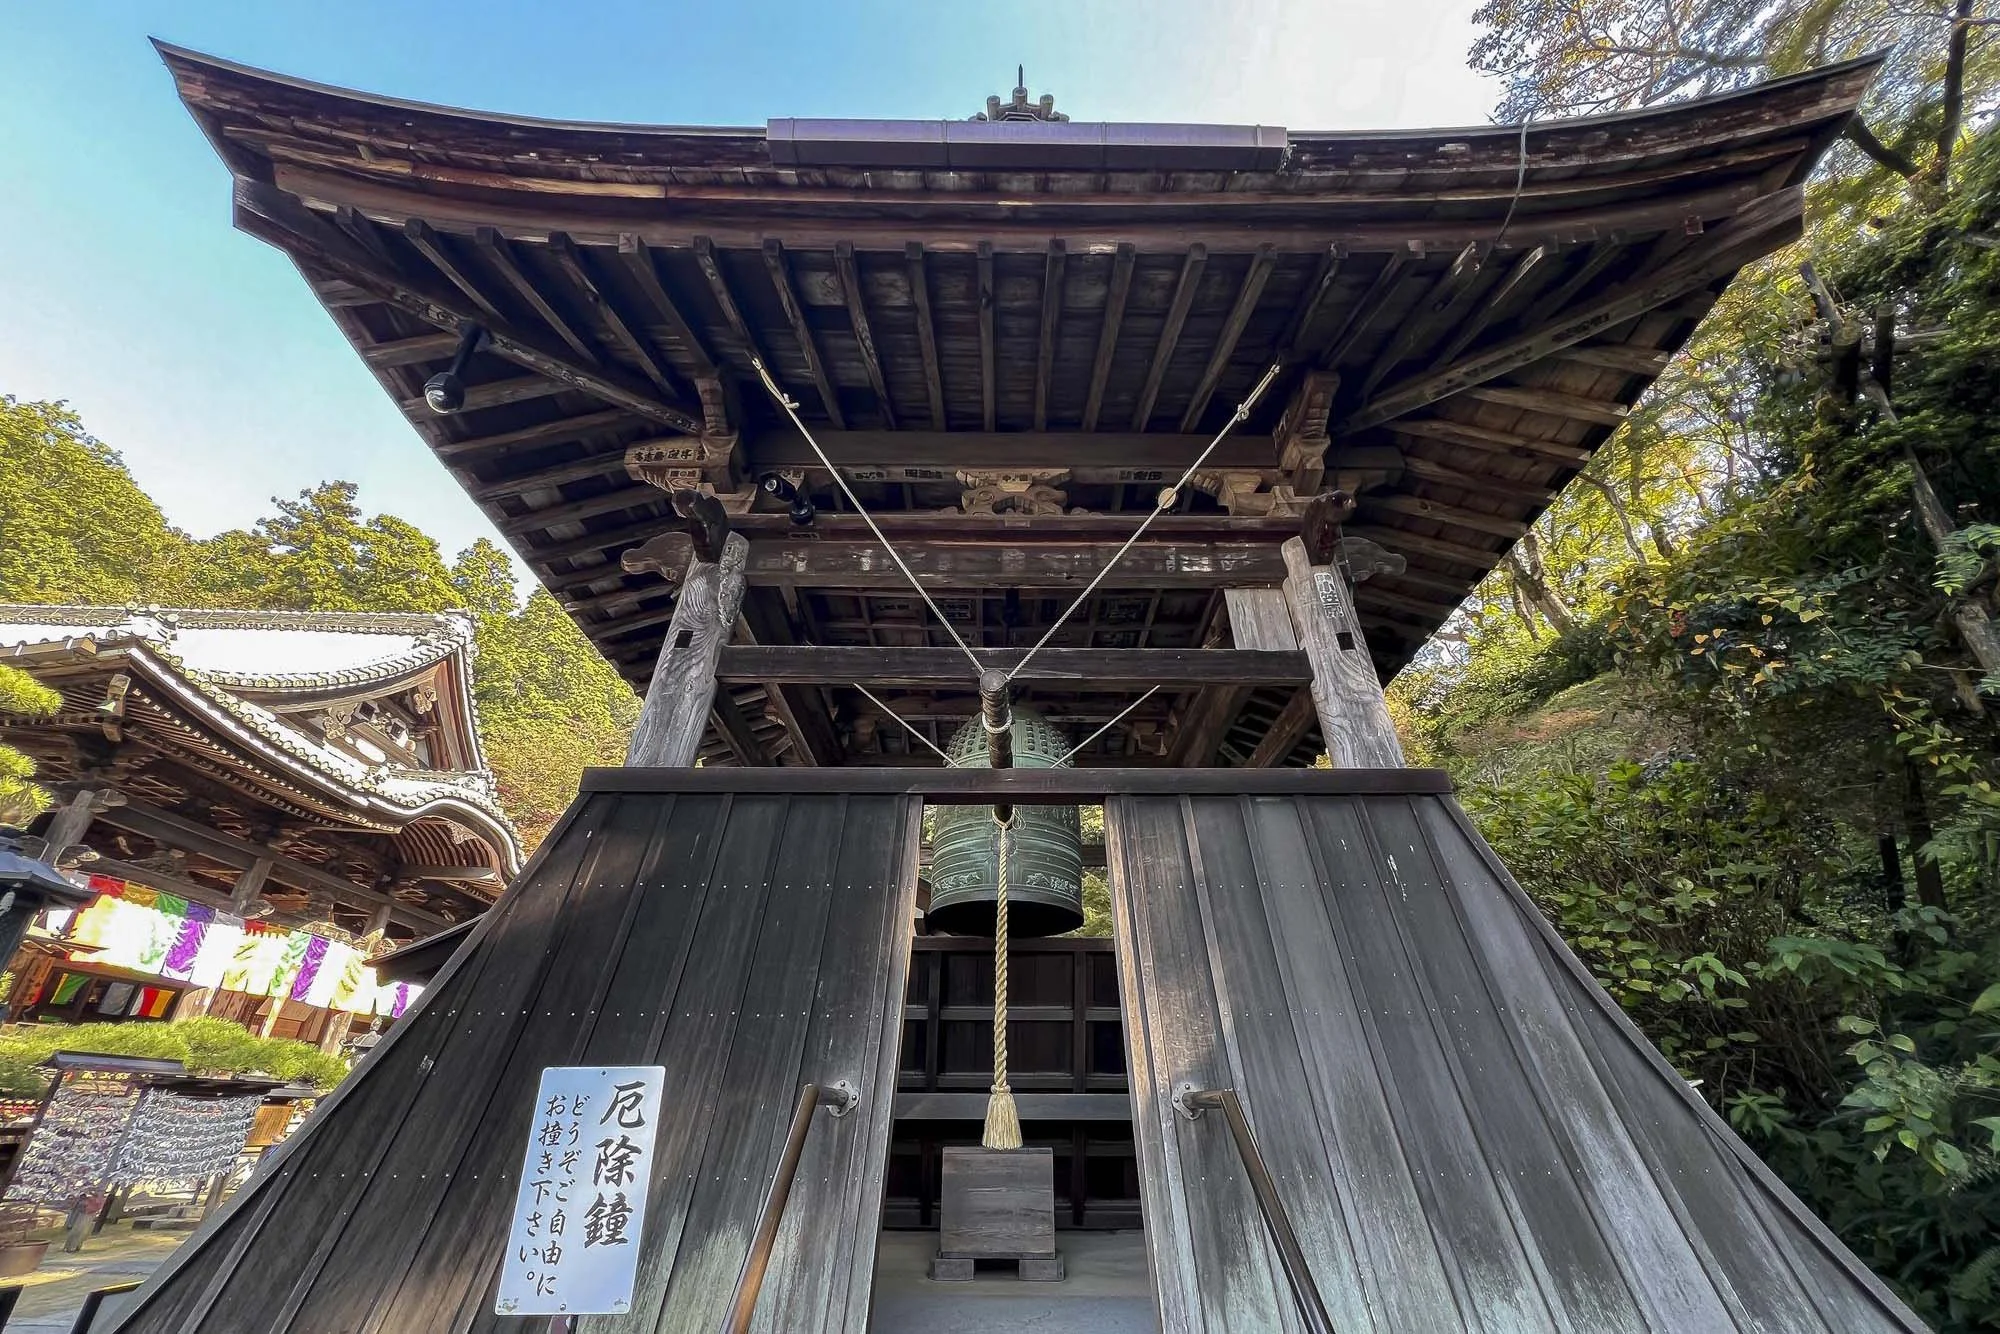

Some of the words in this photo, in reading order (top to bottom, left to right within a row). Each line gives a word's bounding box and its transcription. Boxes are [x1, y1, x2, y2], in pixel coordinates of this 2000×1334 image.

[519, 1096, 566, 1281] お撞き下さい。
[537, 1094, 591, 1296] どうぞご自由に
[584, 1081, 646, 1249] 厄除鐘
